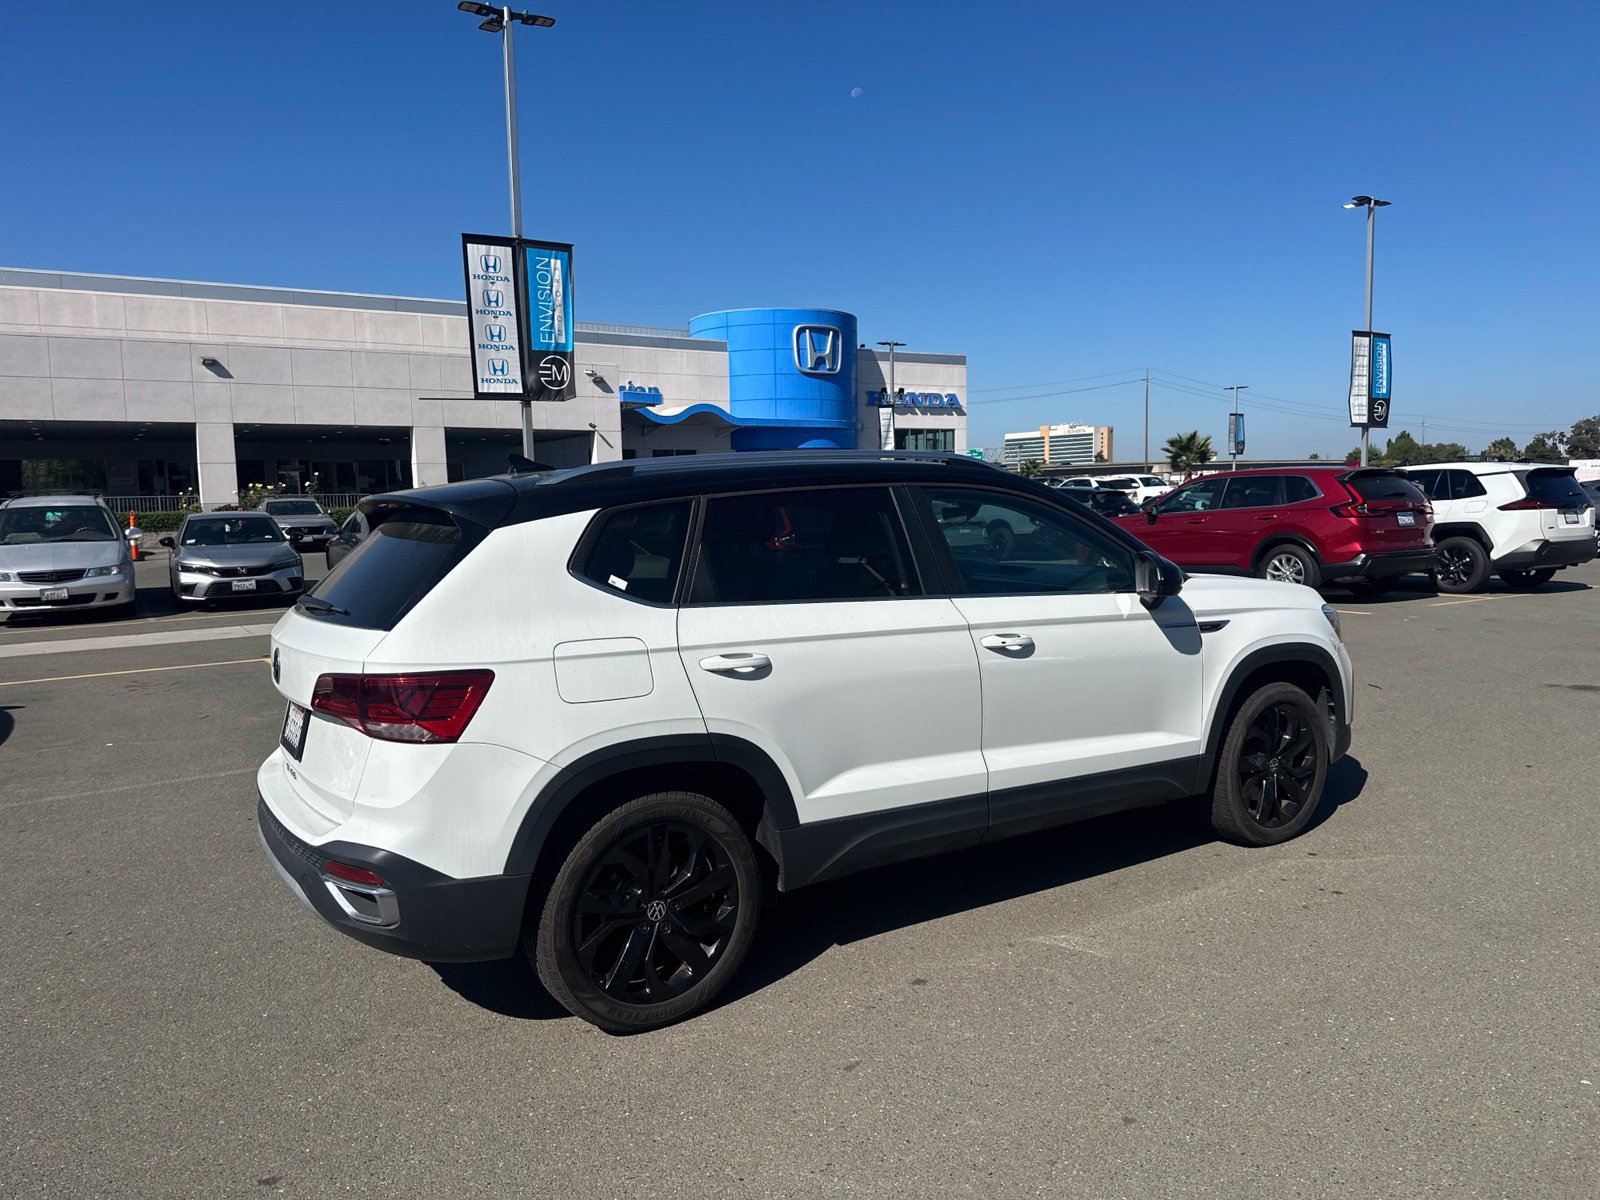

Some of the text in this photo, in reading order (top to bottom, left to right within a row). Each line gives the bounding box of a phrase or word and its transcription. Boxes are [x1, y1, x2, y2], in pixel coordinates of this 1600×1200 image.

[472, 273, 511, 283] HONDA
[535, 256, 555, 343] ENVISION
[475, 308, 513, 317] HONDA
[478, 343, 516, 351] HONDA
[1375, 342, 1383, 394] ENVISION
[480, 376, 519, 385] HONDA
